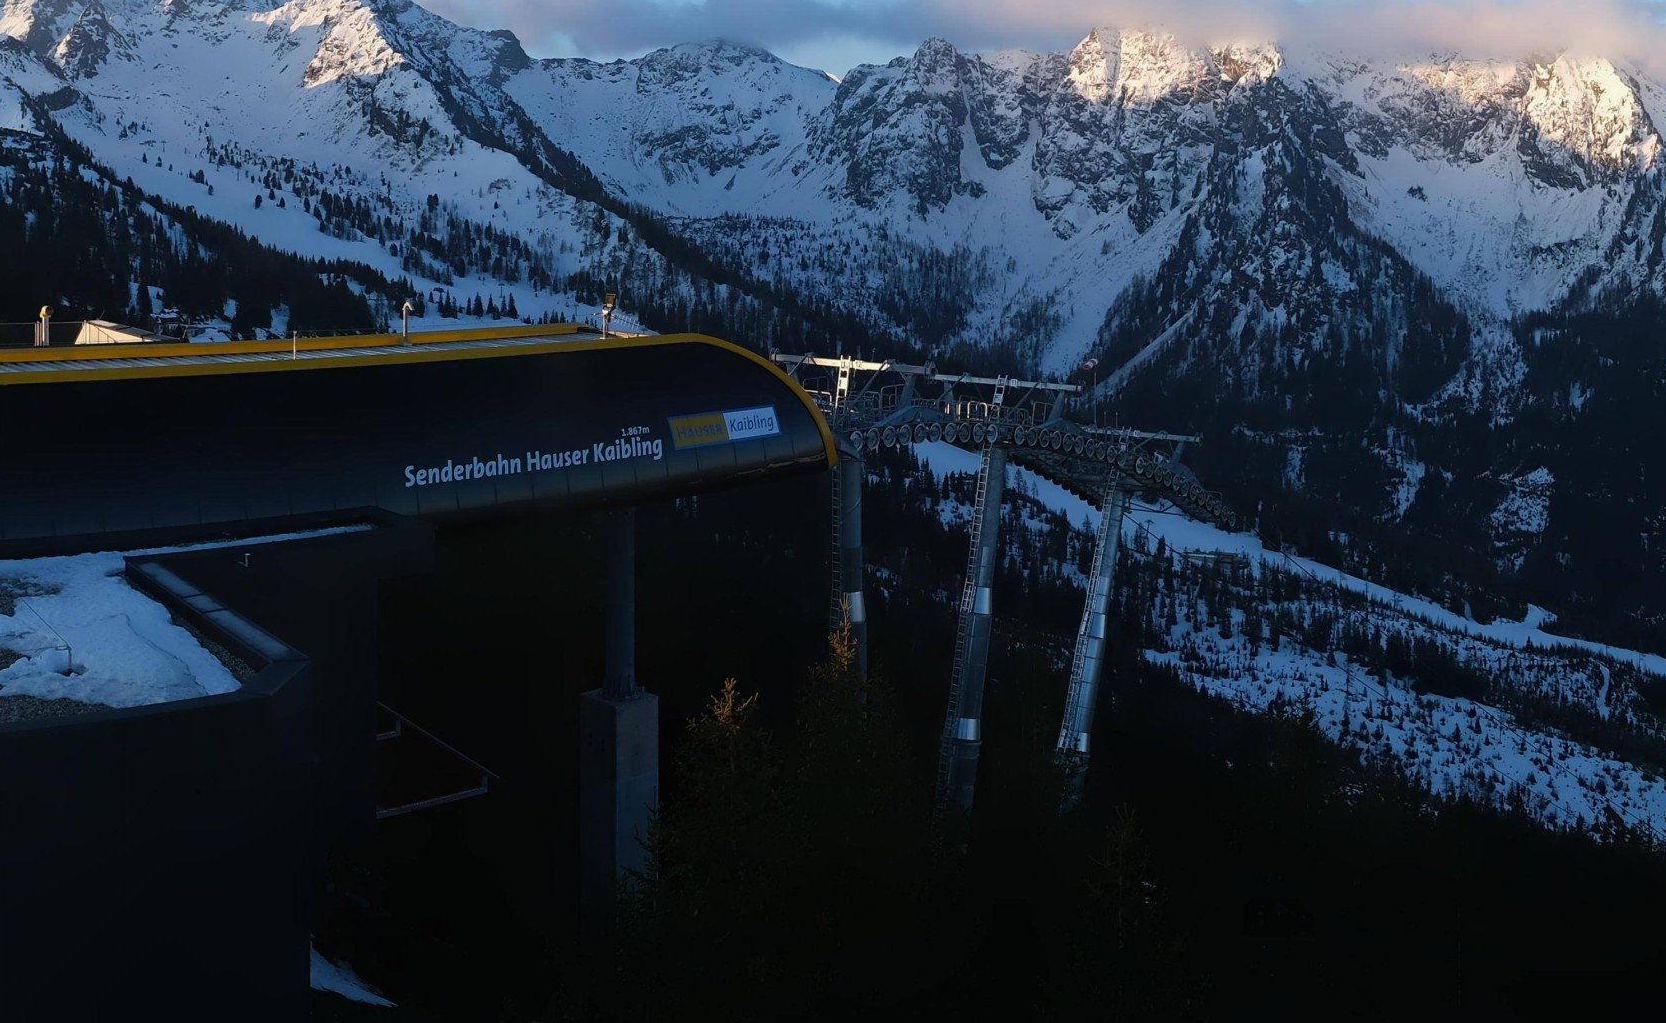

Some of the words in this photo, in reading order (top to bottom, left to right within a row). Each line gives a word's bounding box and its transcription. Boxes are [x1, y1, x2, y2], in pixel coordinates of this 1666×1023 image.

[621, 426, 650, 437] 1.867m
[677, 424, 723, 441] HAUSER
[729, 415, 774, 432] Kaibling
[404, 453, 522, 487] Senderbahn
[526, 448, 589, 472] Hauser
[593, 437, 663, 463] Kaibling
